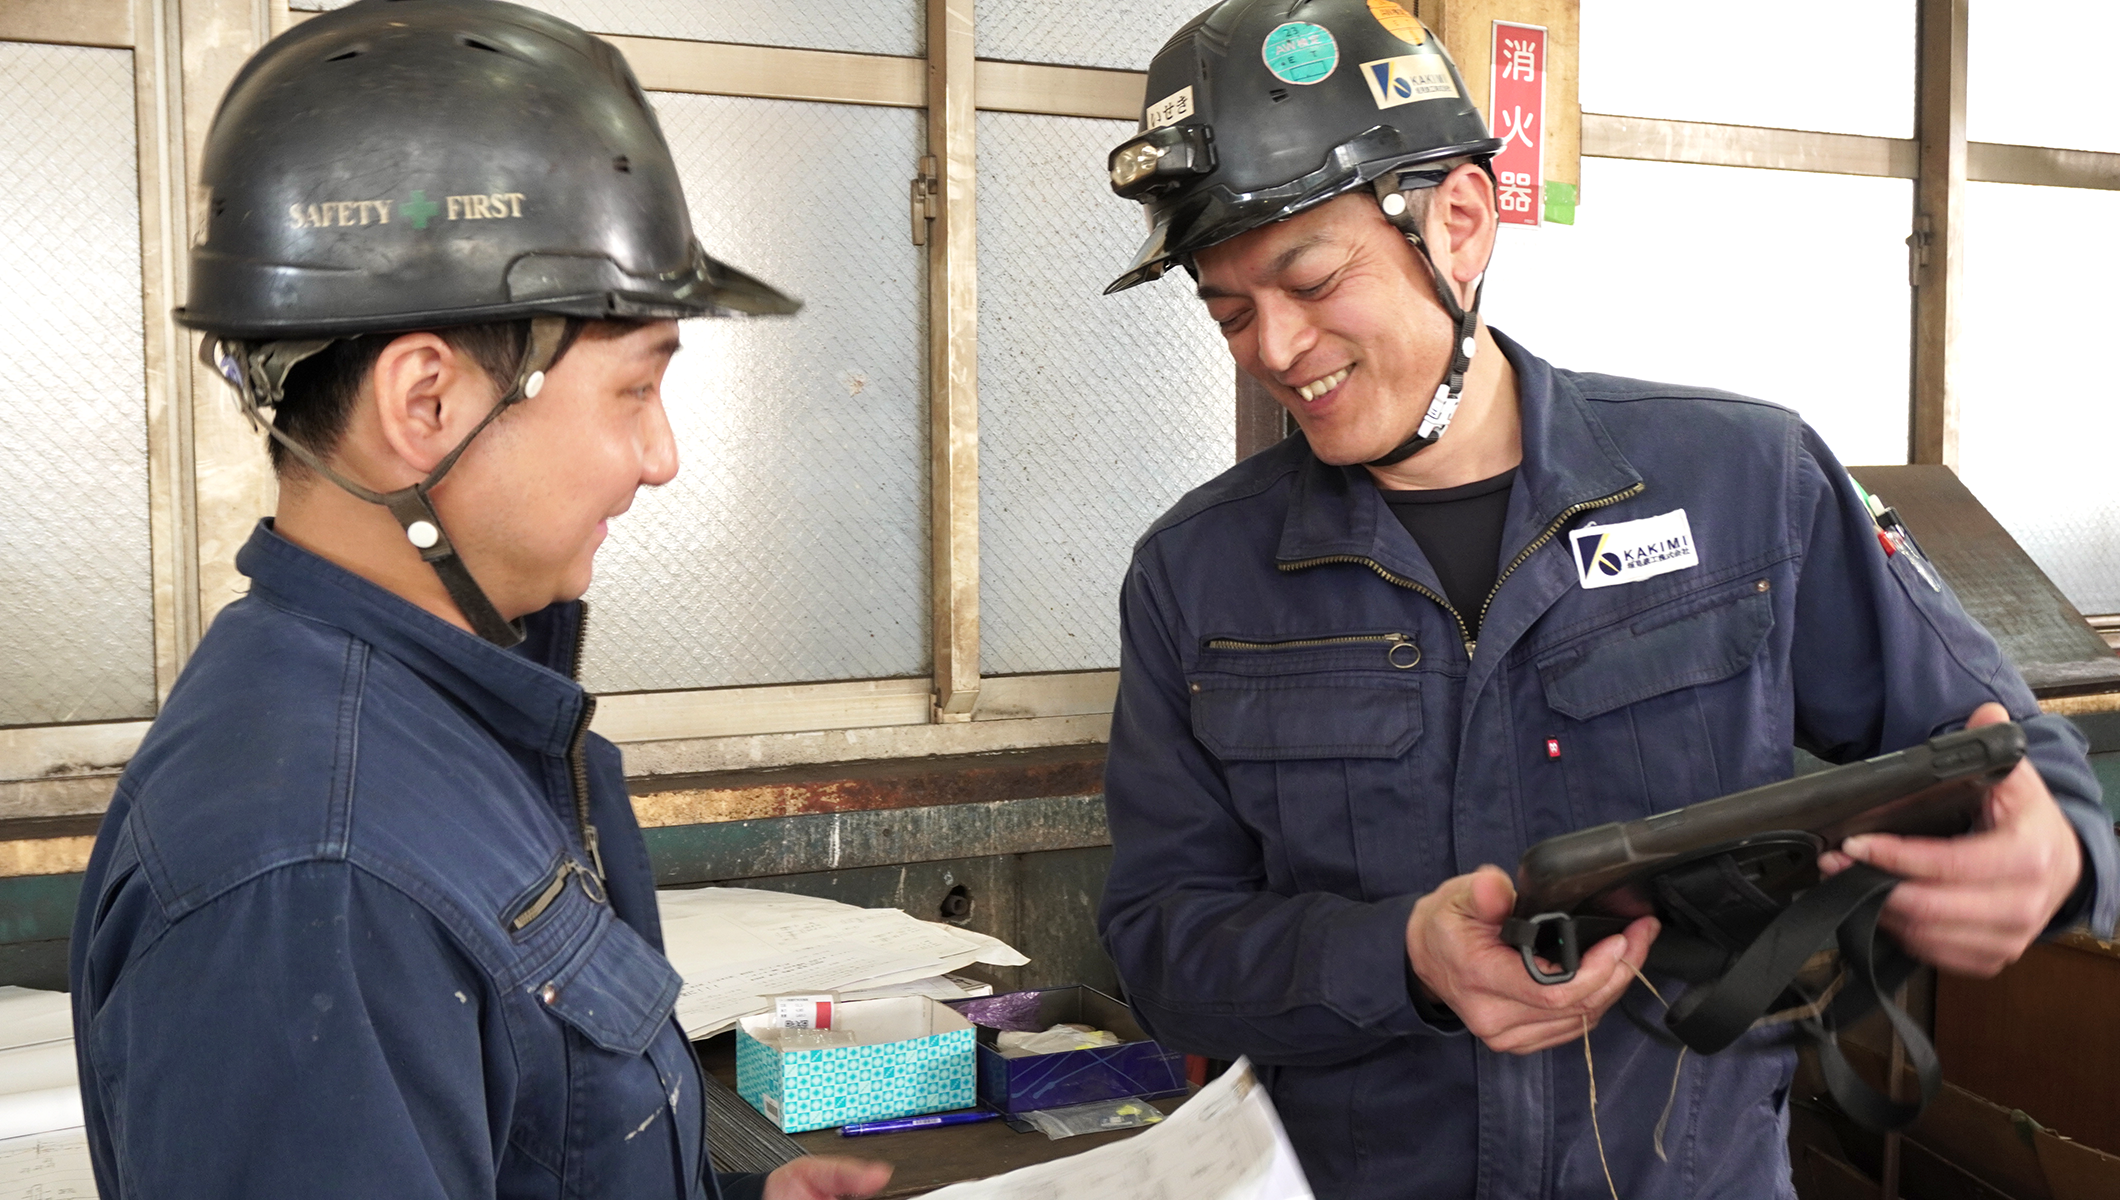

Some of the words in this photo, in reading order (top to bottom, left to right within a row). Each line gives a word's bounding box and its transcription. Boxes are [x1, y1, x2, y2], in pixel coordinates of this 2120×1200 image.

[1150, 95, 1188, 127] いせき
[1499, 38, 1536, 212] 消火器
[288, 199, 394, 230] SAFETY
[446, 192, 526, 221] FIRST
[1623, 535, 1689, 562] KAKIMI
